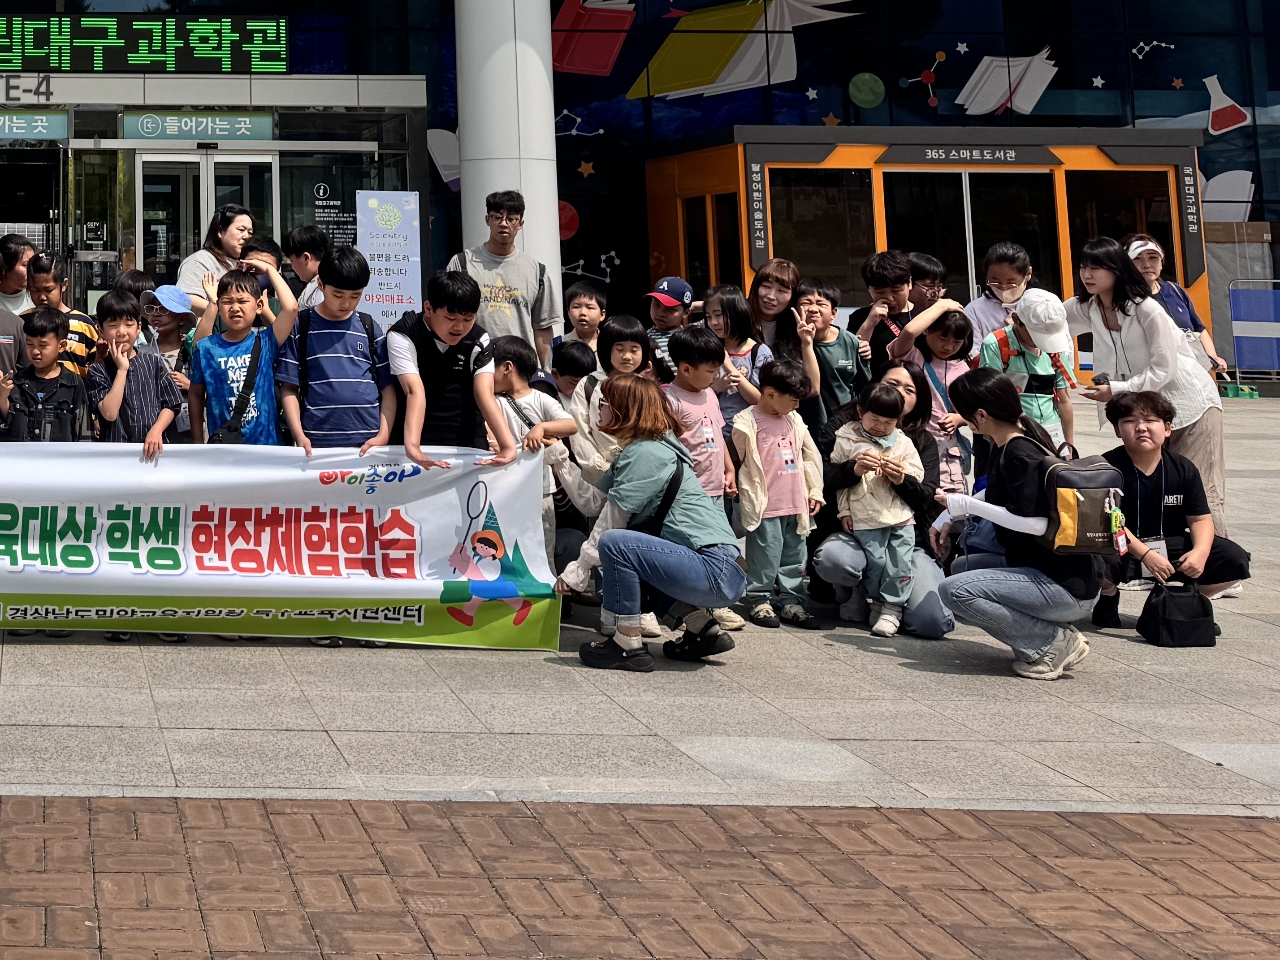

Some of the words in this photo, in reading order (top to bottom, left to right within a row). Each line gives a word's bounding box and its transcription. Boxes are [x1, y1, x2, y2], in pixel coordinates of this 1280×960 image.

[31, 116, 49, 134] 곳
[163, 117, 230, 135] 들어가는
[234, 117, 252, 136] 곳
[925, 149, 946, 159] 365
[949, 149, 1017, 161] 스마트도서관
[1184, 166, 1198, 233] 국립대구과학관
[378, 281, 401, 291] 반드시
[364, 293, 416, 305] 야외매표소
[381, 309, 397, 319] 에서
[107, 504, 181, 569] 학생
[191, 505, 418, 579] 현장체험학습
